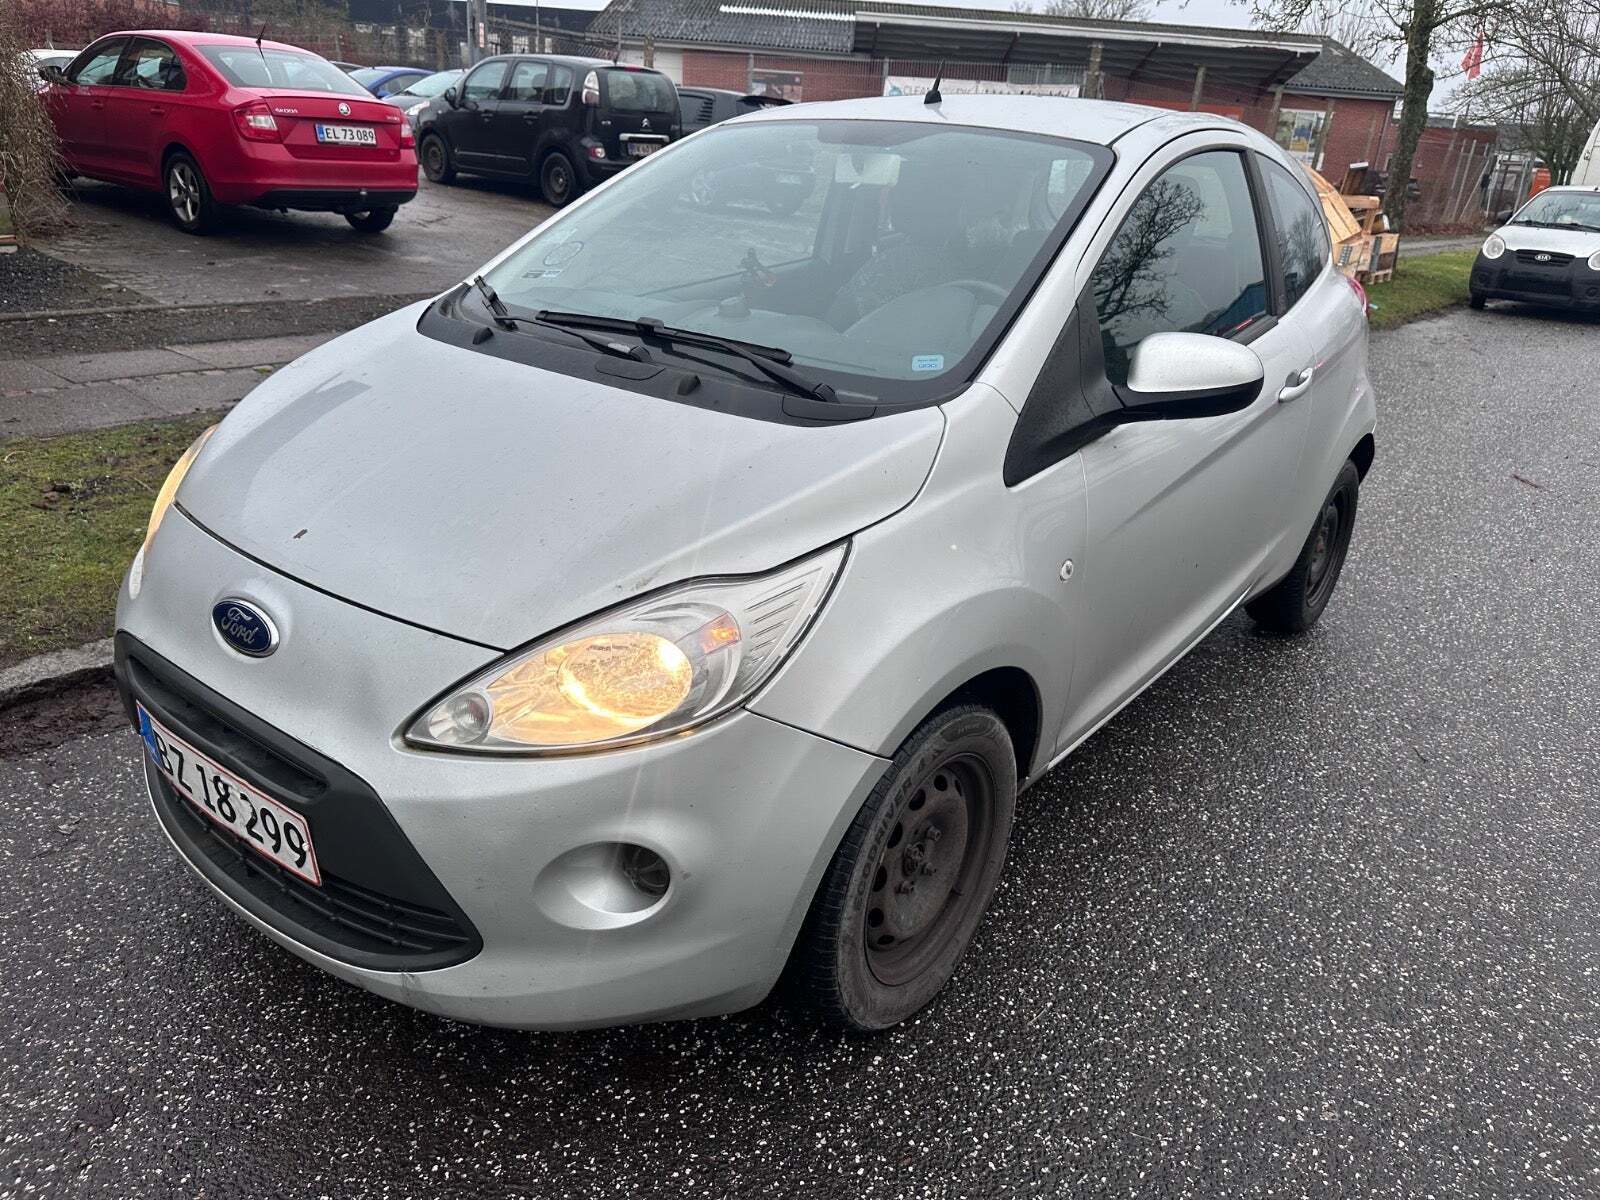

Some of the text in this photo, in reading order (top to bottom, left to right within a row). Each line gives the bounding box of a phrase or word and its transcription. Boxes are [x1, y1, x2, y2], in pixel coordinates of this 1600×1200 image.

[325, 128, 374, 142] EL 73 089
[219, 606, 260, 645] Ford
[155, 734, 308, 869] BZ 18 299
